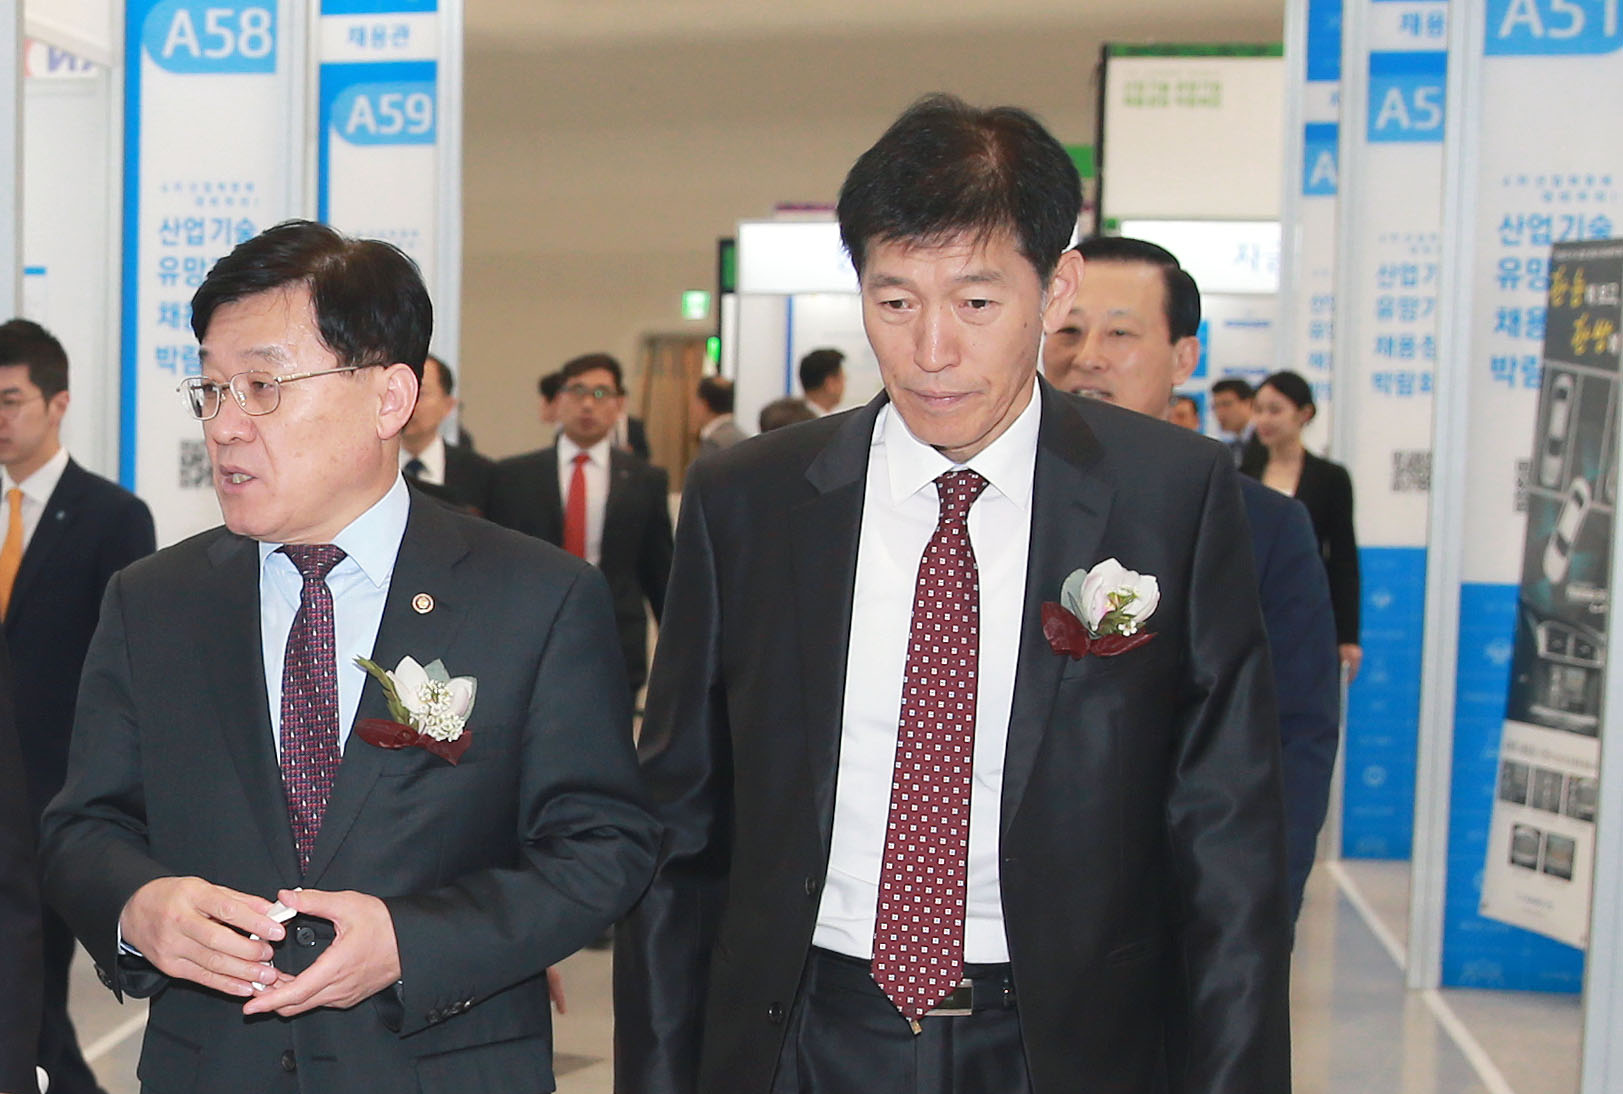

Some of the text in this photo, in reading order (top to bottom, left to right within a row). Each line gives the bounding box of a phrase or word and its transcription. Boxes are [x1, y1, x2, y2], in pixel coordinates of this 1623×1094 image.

[162, 7, 274, 59] A58
[346, 92, 434, 135] A59
[1377, 86, 1442, 130] A5
